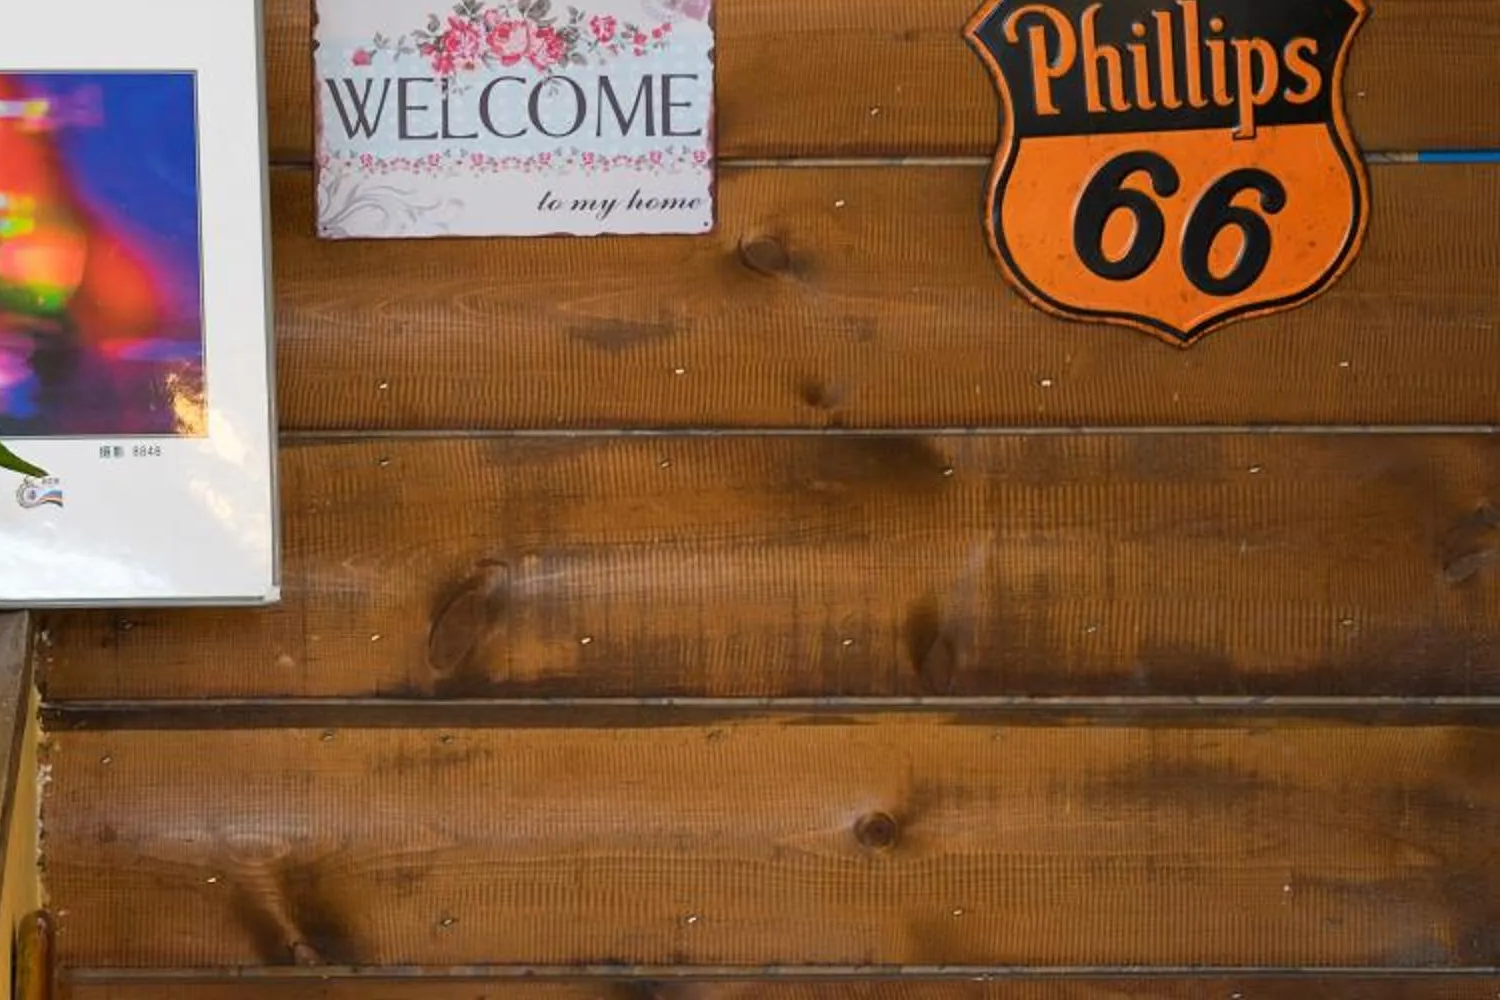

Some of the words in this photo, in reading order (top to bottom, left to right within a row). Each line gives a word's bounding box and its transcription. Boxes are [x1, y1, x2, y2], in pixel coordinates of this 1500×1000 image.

[325, 73, 703, 140] WELCOME
[537, 190, 562, 212] to
[570, 198, 620, 221] my
[626, 187, 703, 212] home
[1073, 149, 1288, 297] 66
